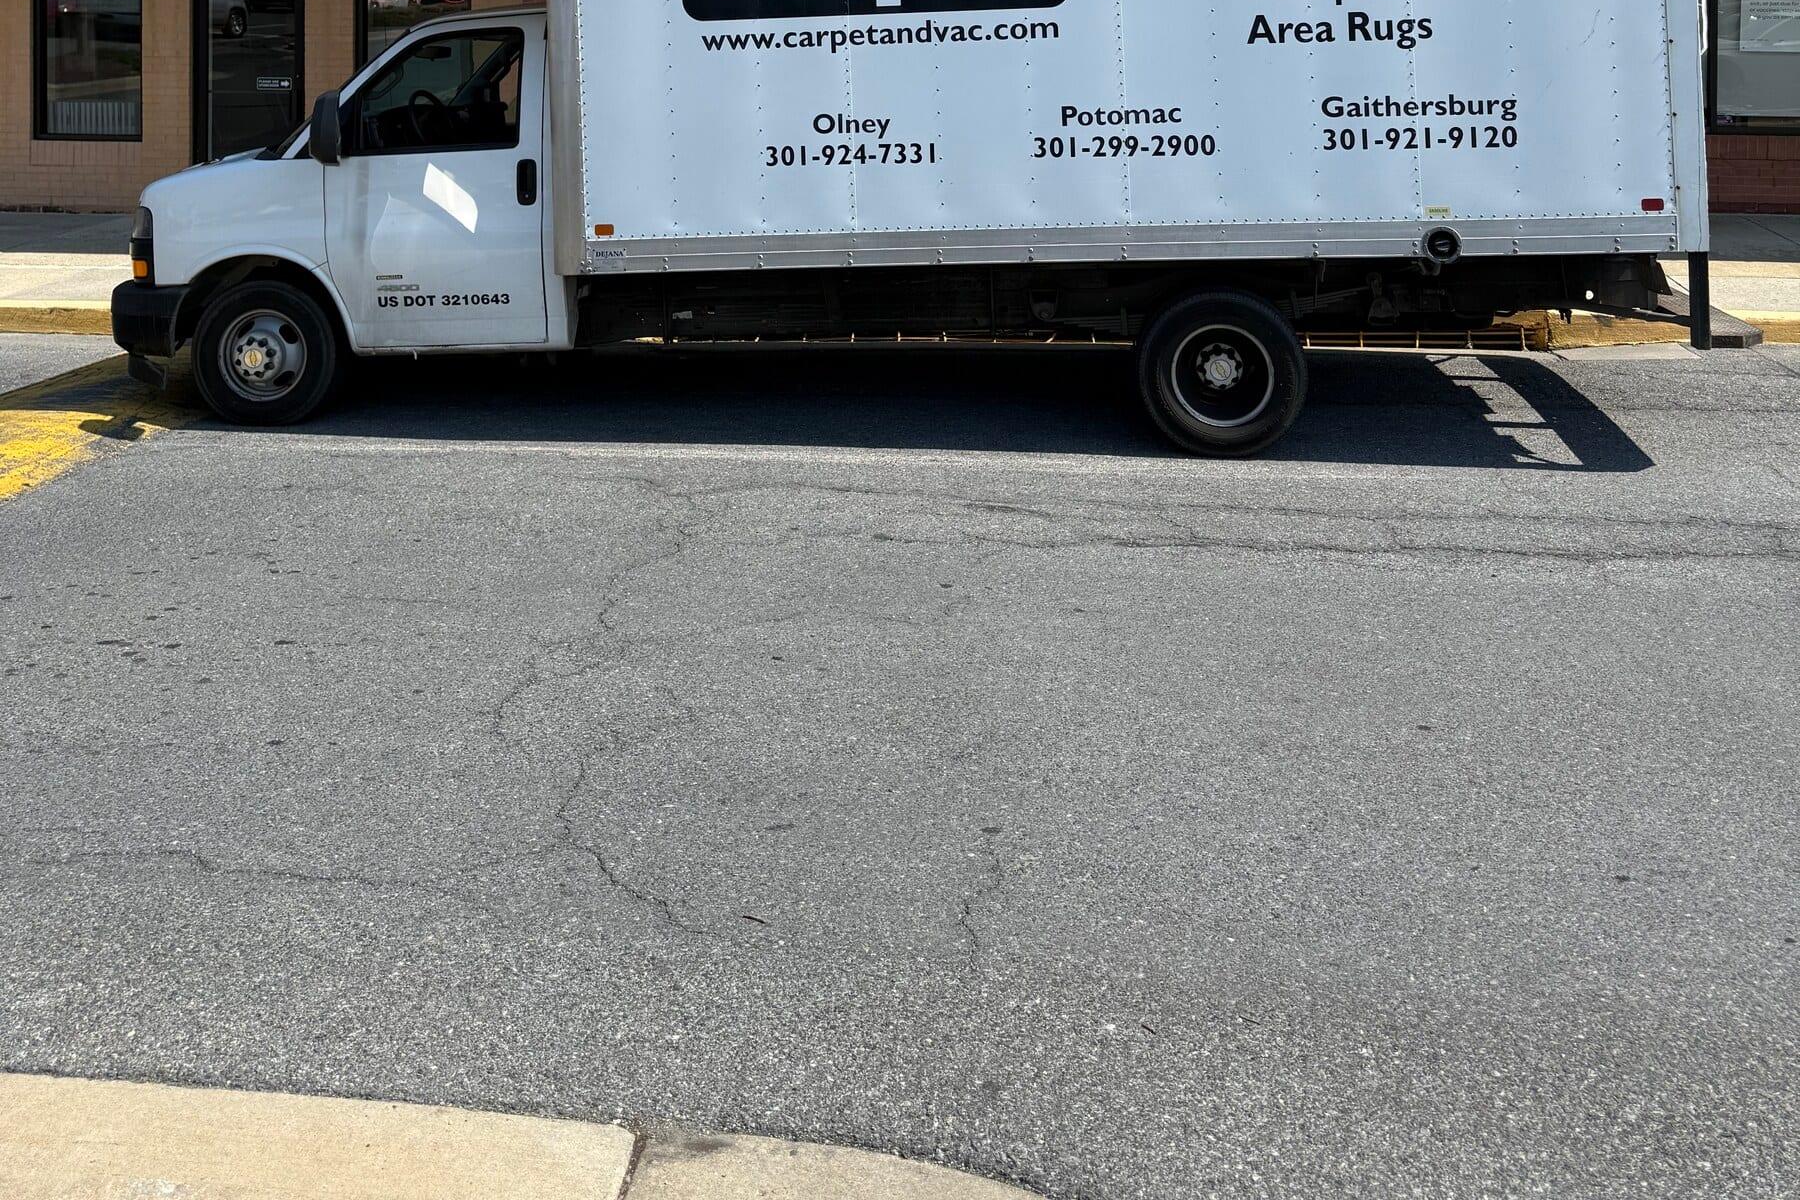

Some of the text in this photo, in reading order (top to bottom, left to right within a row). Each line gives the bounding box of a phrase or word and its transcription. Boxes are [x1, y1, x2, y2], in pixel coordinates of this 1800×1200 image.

[701, 19, 1059, 53] www.carpetandvac.com
[1247, 11, 1433, 49] Area Rugs
[1061, 105, 1182, 127] Potomac
[1321, 93, 1517, 121] Gaithersburg
[813, 113, 891, 139] Olney
[1323, 125, 1518, 151] 301-921-9120
[766, 142, 936, 167] 301-924-7331
[1034, 134, 1216, 158] 301-299-2900
[378, 293, 511, 307] US DOT 3210643
